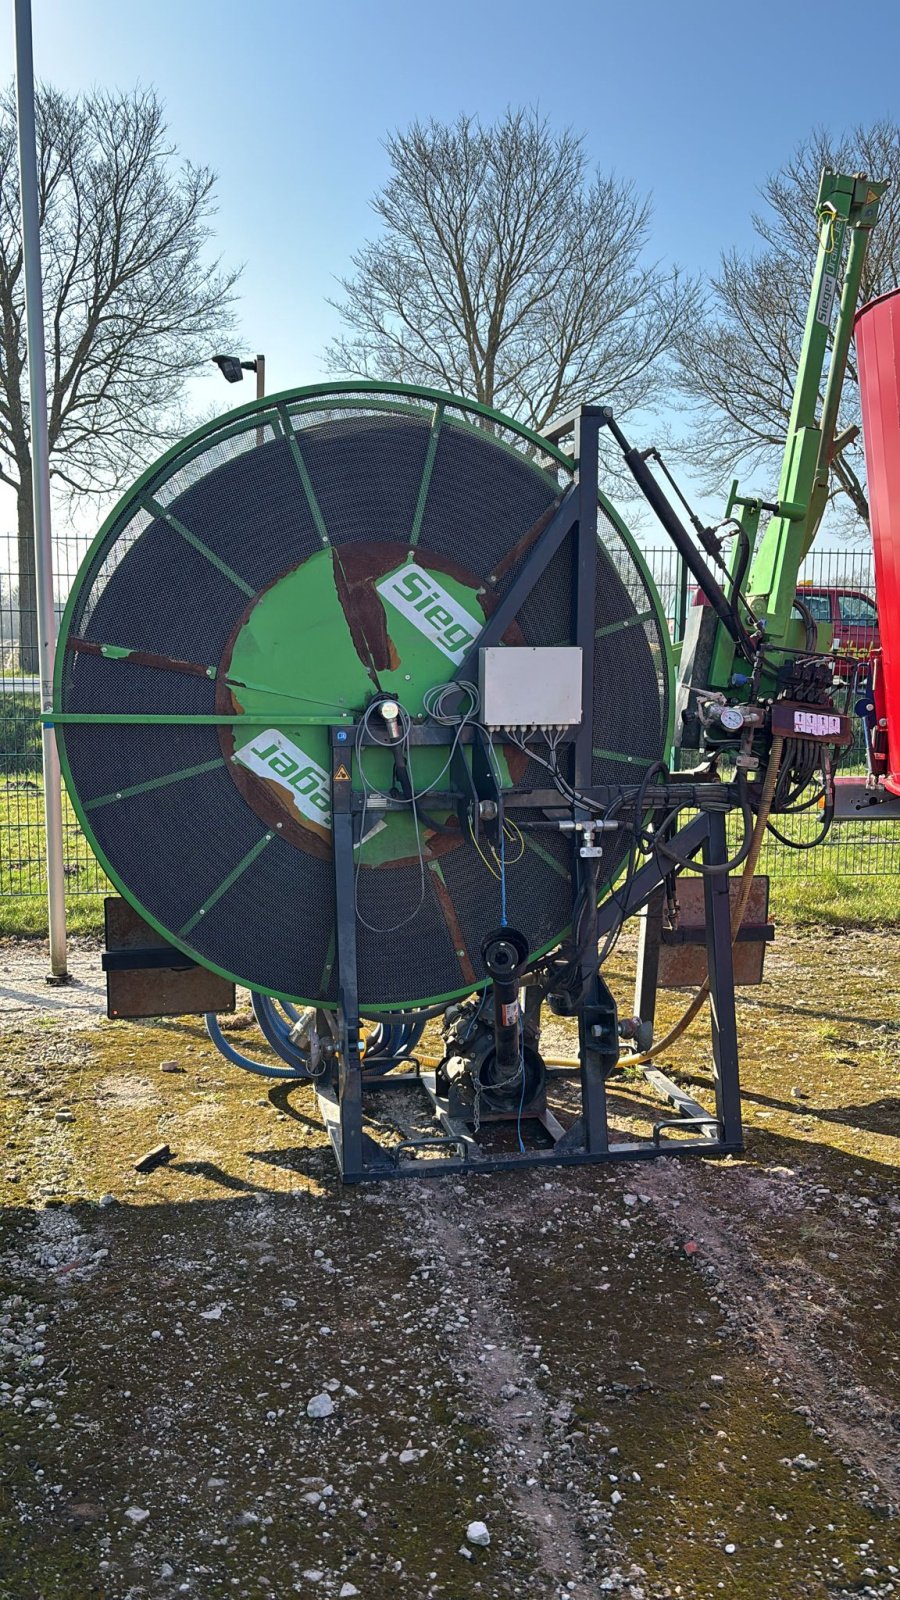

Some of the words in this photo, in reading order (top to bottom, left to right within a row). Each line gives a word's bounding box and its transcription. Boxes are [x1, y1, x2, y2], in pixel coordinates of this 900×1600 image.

[818, 276, 833, 322] Sieger
[826, 215, 844, 274] Drain-Je
[392, 571, 475, 657] Sieg
[250, 743, 332, 825] eger
